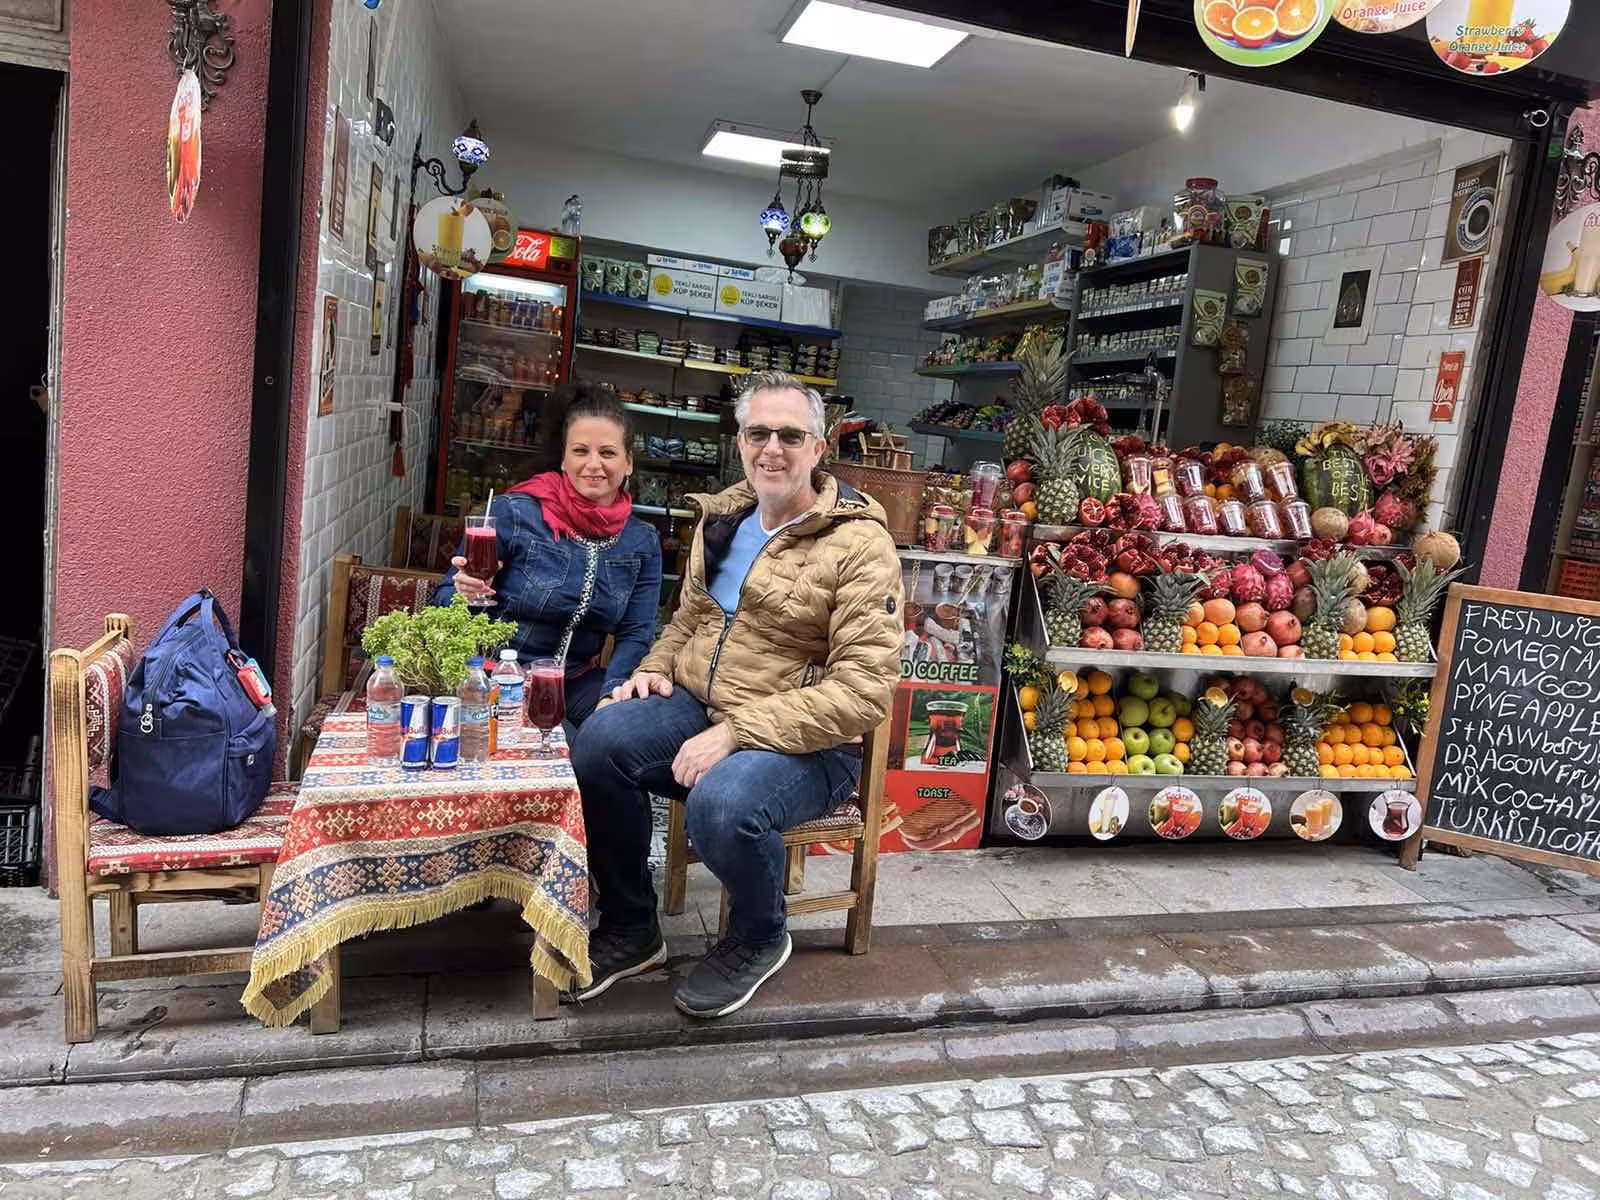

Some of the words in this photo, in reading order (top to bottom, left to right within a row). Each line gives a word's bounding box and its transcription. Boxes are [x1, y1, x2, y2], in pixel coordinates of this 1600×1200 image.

[1342, 5, 1391, 19] Orange
[1391, 0, 1427, 13] Juice
[1455, 25, 1526, 37] Strawberry
[1449, 41, 1492, 52] Orange
[1494, 41, 1526, 51] Juice
[1322, 457, 1355, 471] BEST
[1331, 481, 1370, 503] BEST
[917, 662, 980, 681] COFFEE
[1454, 657, 1592, 699] MANGO
[938, 756, 957, 766] TEA
[1444, 743, 1559, 777] DRAGON
[917, 787, 949, 798] TOAST
